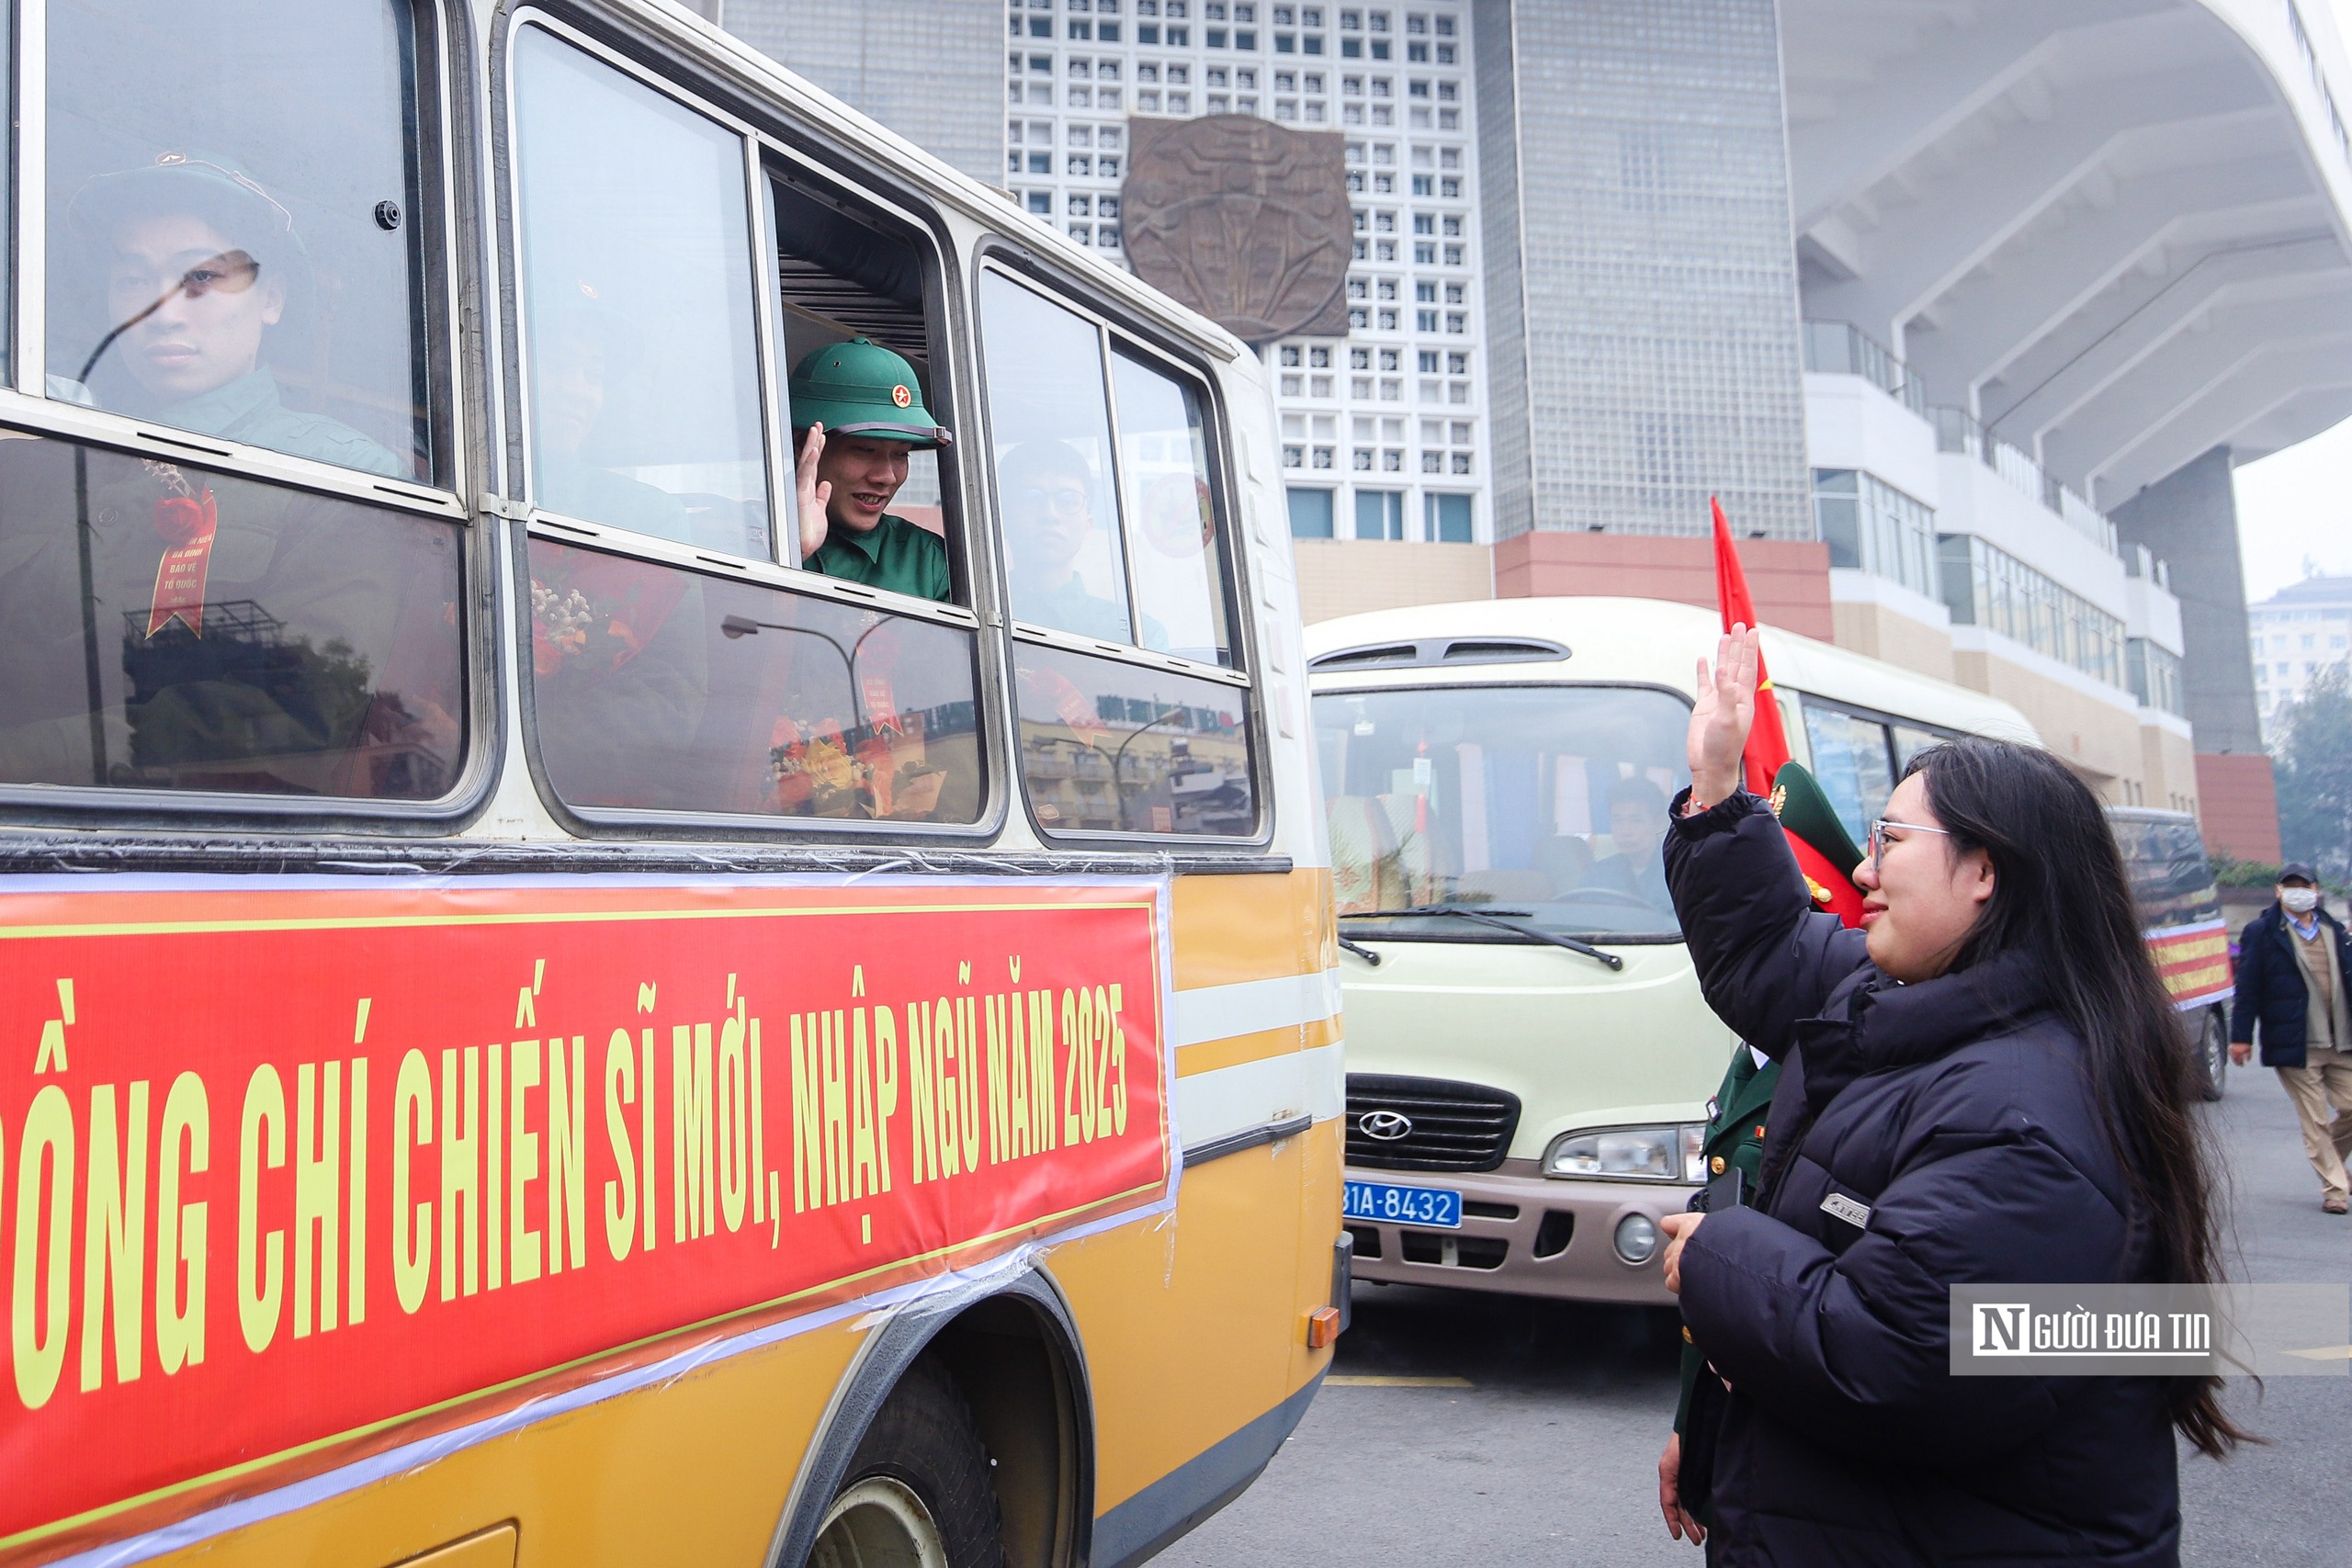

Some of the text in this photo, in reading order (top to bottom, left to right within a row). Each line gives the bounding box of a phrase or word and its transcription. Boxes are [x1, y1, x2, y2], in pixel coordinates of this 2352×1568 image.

[0, 955, 1127, 1409] ỒNG CHÍ CHIẾN SĨ MỚI, NHẬP NGŨ NĂM 2025
